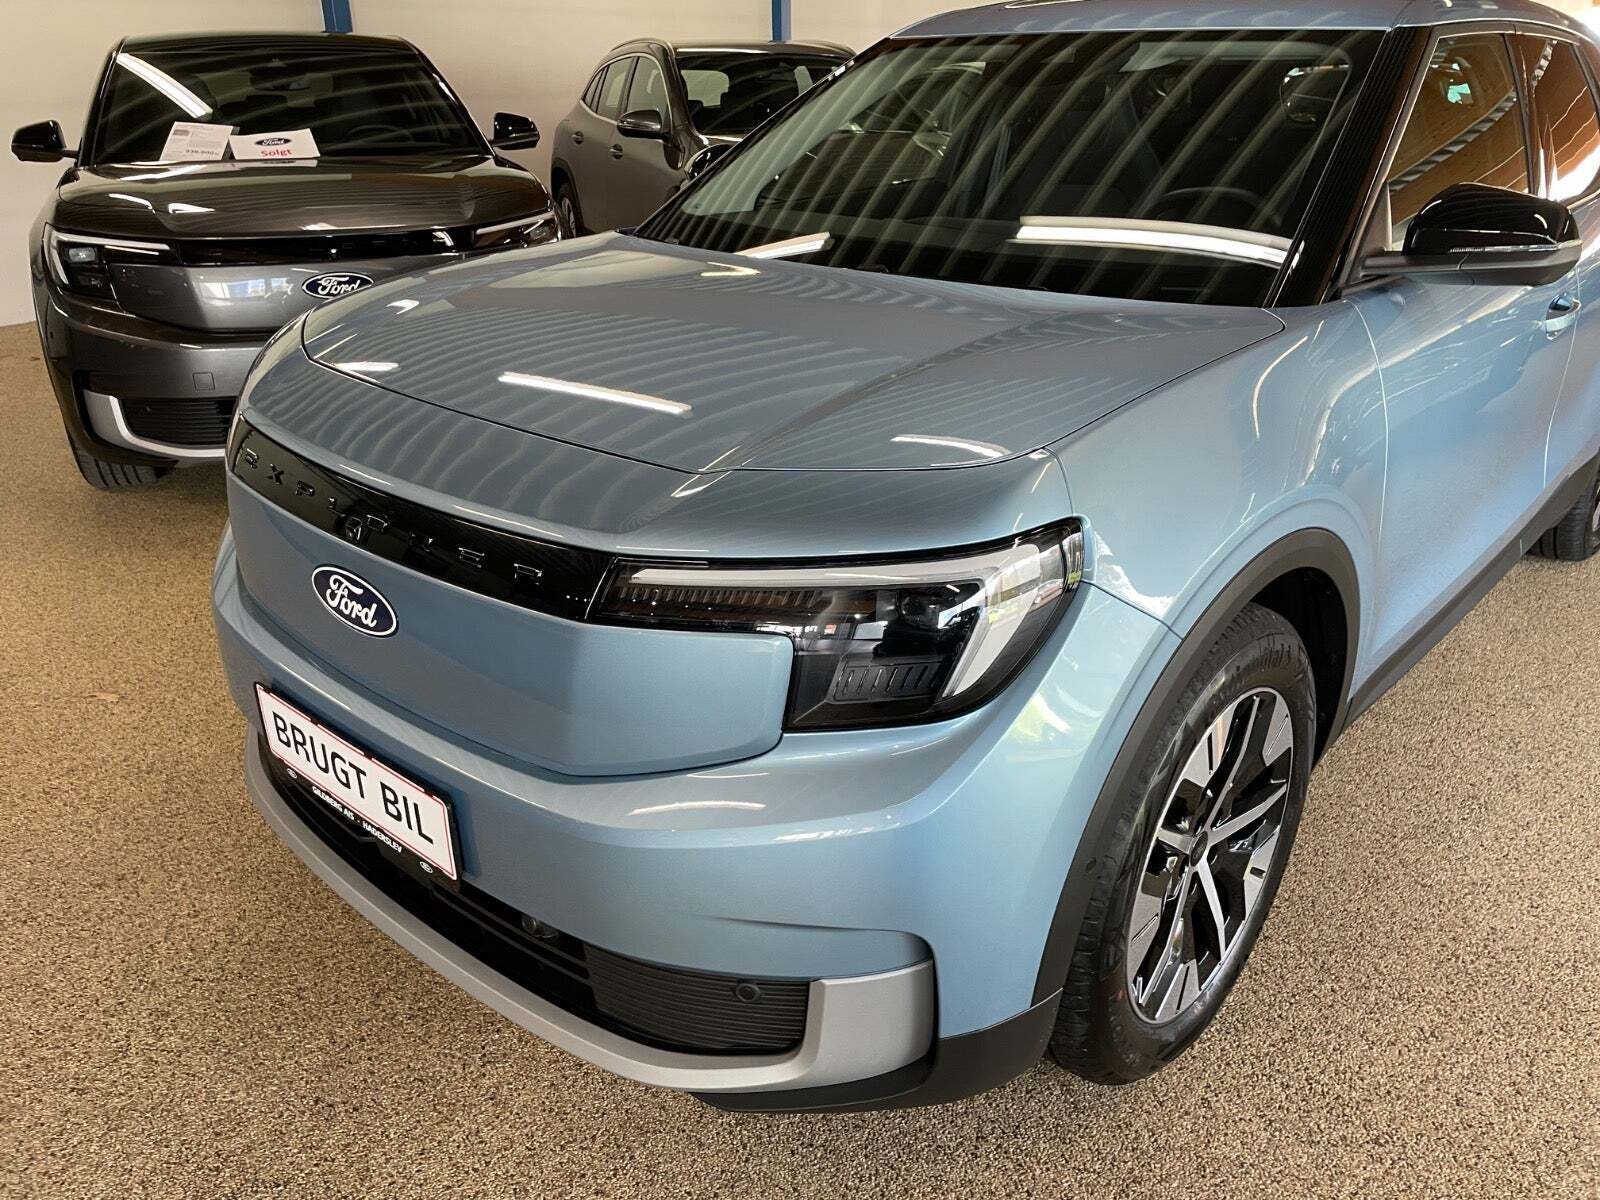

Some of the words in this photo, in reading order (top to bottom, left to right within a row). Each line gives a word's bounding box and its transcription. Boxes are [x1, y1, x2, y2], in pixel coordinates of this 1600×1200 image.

[261, 149, 292, 158] Solgt
[317, 277, 361, 295] Ford
[325, 574, 378, 629] Ford
[272, 711, 367, 799] BRUGT
[380, 781, 434, 845] BIL
[362, 820, 402, 853] HADERSLEV
